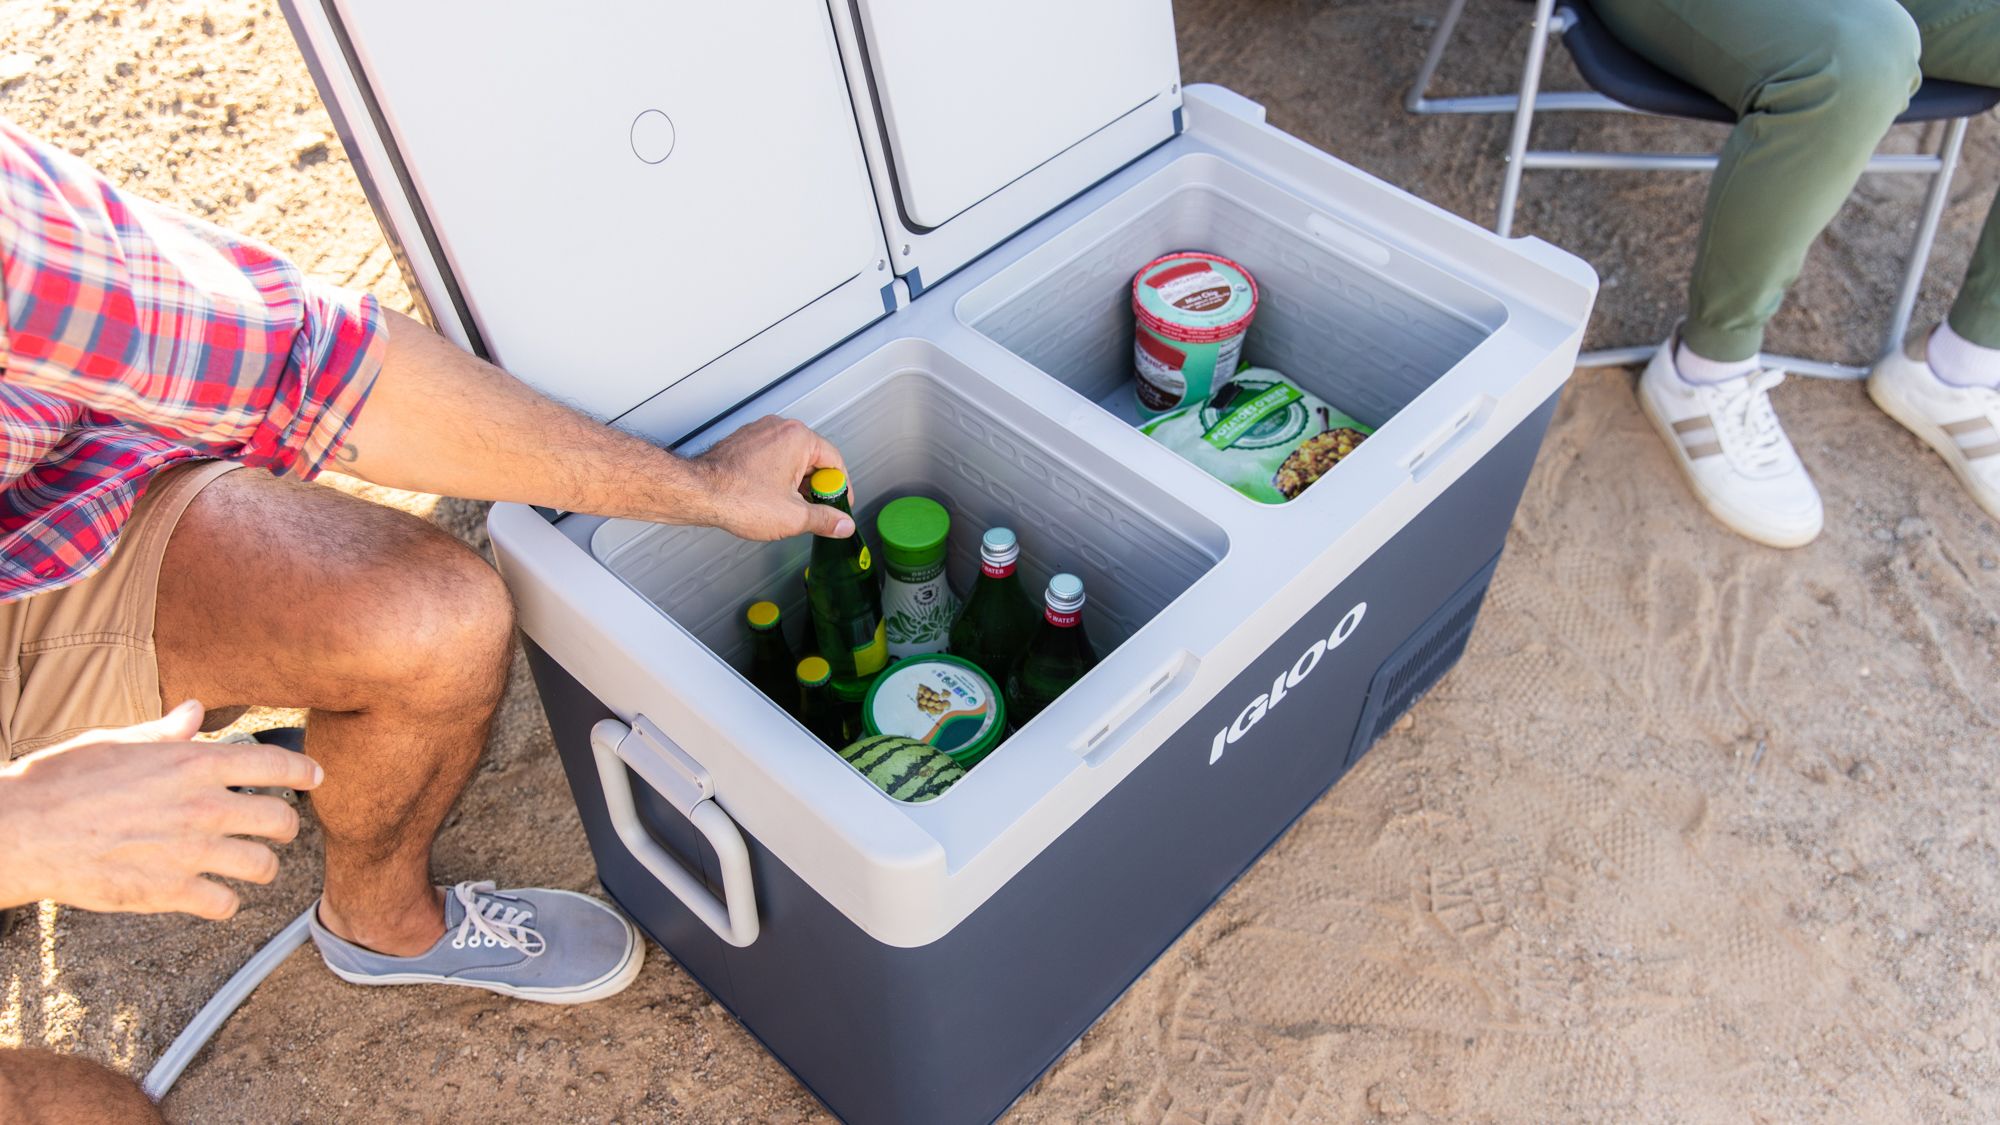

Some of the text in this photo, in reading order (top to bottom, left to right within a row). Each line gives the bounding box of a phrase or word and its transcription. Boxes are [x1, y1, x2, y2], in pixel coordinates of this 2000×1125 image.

[1211, 405, 1257, 441] POTATOES
[922, 589, 934, 601] 3
[1052, 615, 1075, 624] WATER
[1209, 602, 1367, 766] IGLOO
